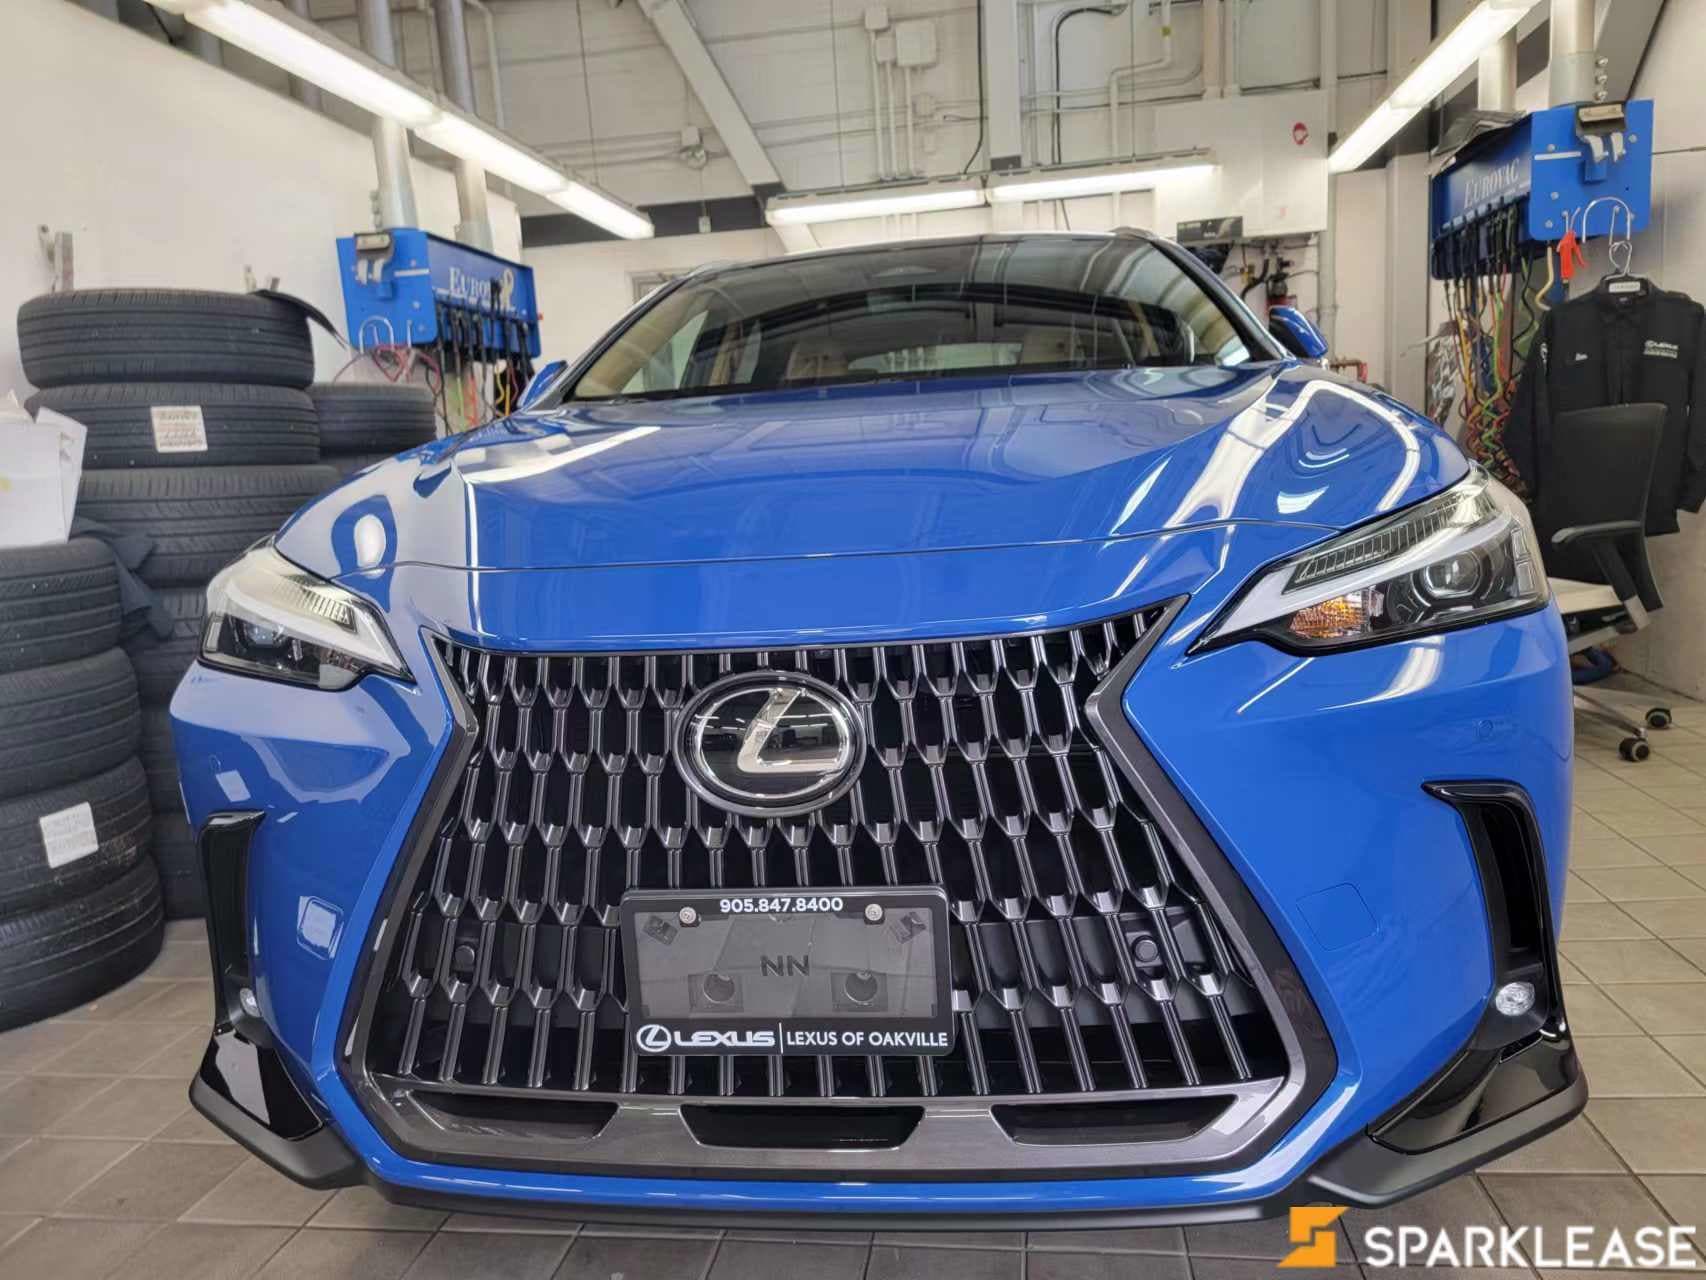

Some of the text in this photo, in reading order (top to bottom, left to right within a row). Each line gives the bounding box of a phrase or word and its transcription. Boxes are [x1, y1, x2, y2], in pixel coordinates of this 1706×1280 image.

[1464, 158, 1520, 210] EUROVAC
[720, 898, 844, 913] 905.847.8400
[674, 1031, 775, 1047] LEXUS
[786, 1031, 948, 1047] LEXUS OF OAKVILLE
